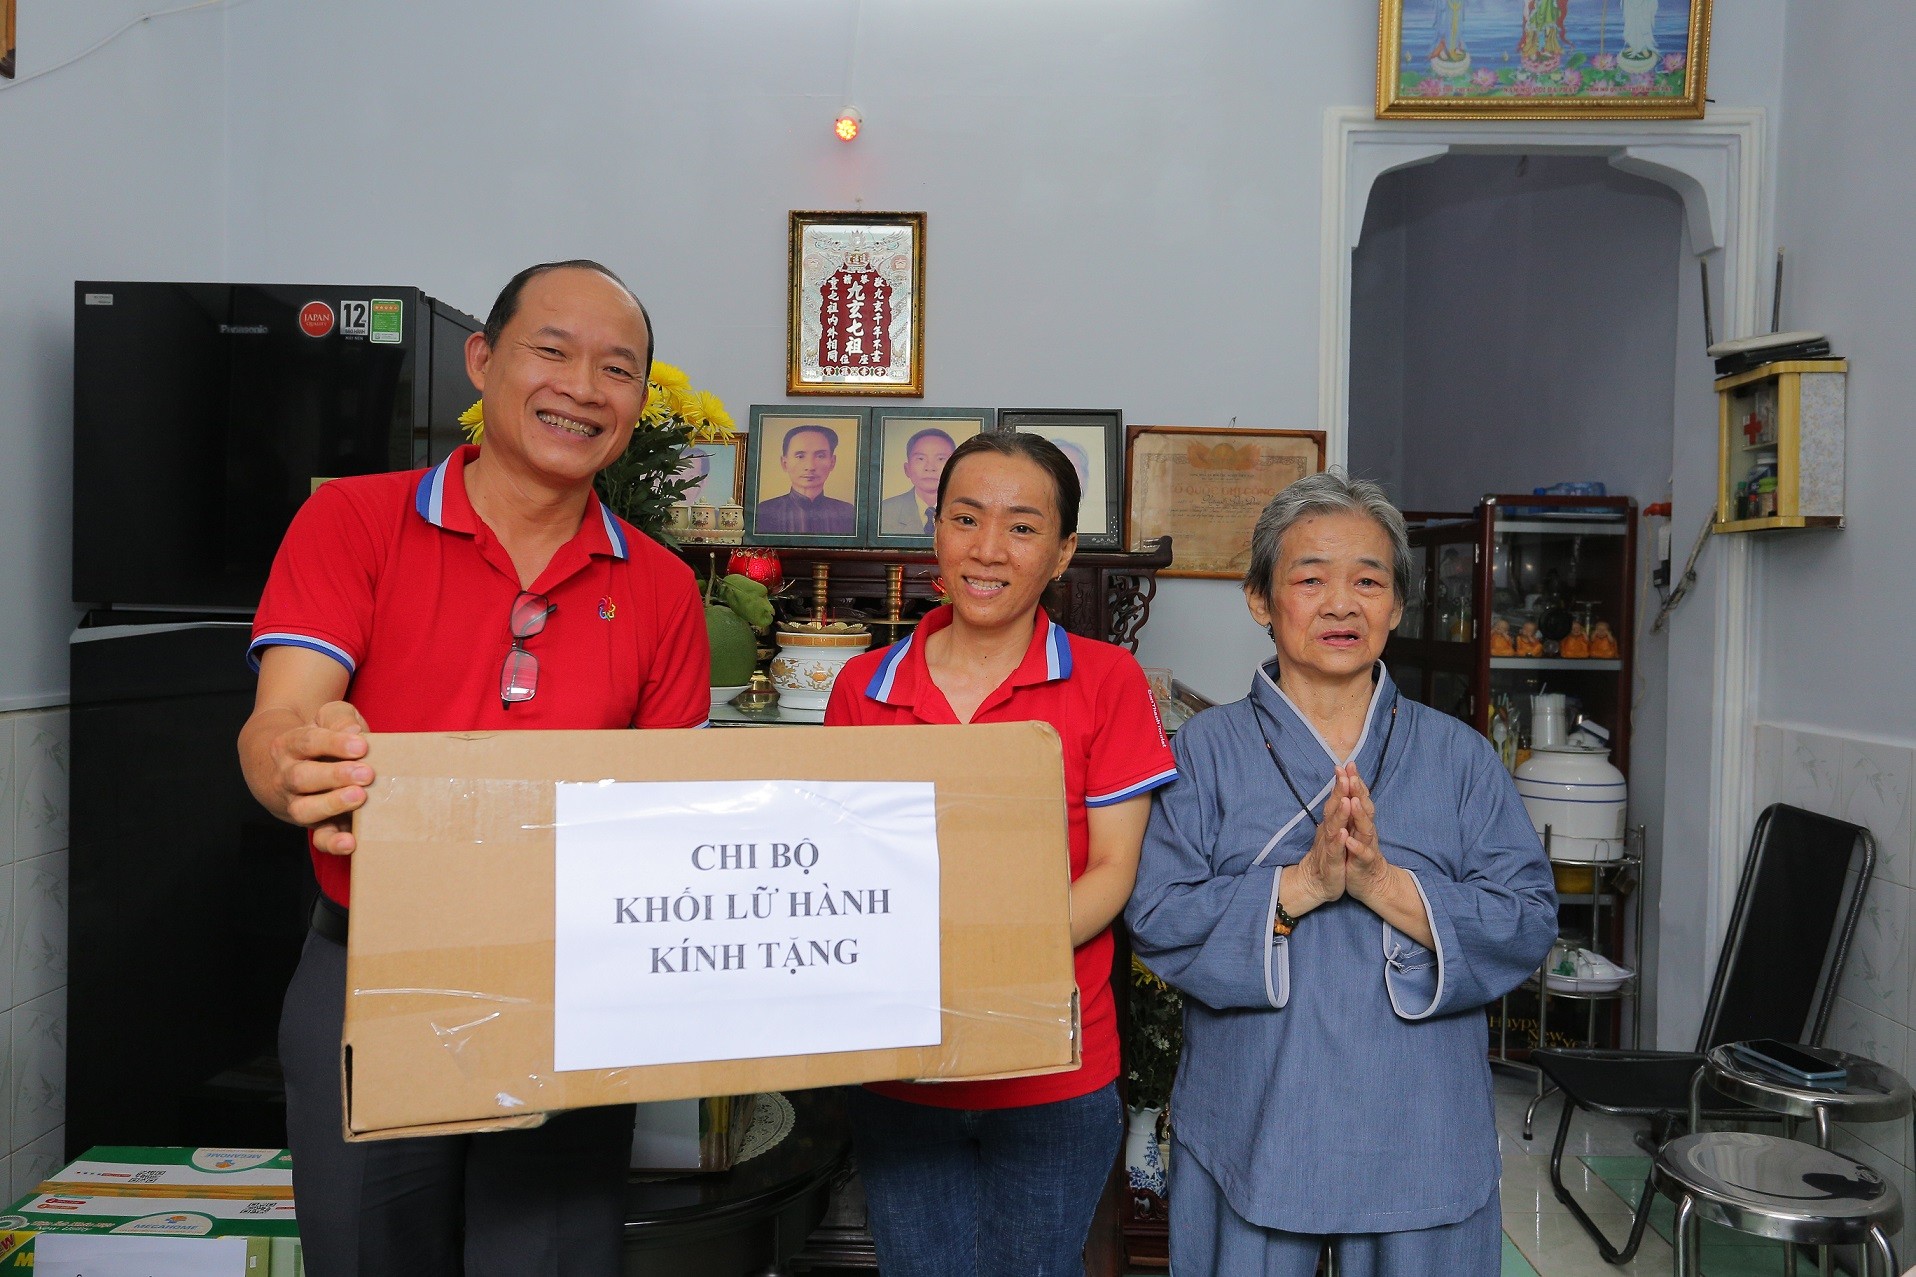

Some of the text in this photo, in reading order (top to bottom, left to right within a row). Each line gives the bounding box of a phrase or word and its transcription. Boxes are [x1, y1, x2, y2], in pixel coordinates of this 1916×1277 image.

[219, 325, 268, 333] Panasonic
[304, 313, 330, 322] JAPAN
[343, 303, 366, 328] 12
[845, 280, 866, 356] 九玄七祖
[691, 837, 819, 875] CHI BỘ
[613, 882, 891, 924] KHỐI LỮ HÀNH
[650, 936, 860, 975] KÍNH TẶNG
[133, 1223, 200, 1231] MEGAHOME
